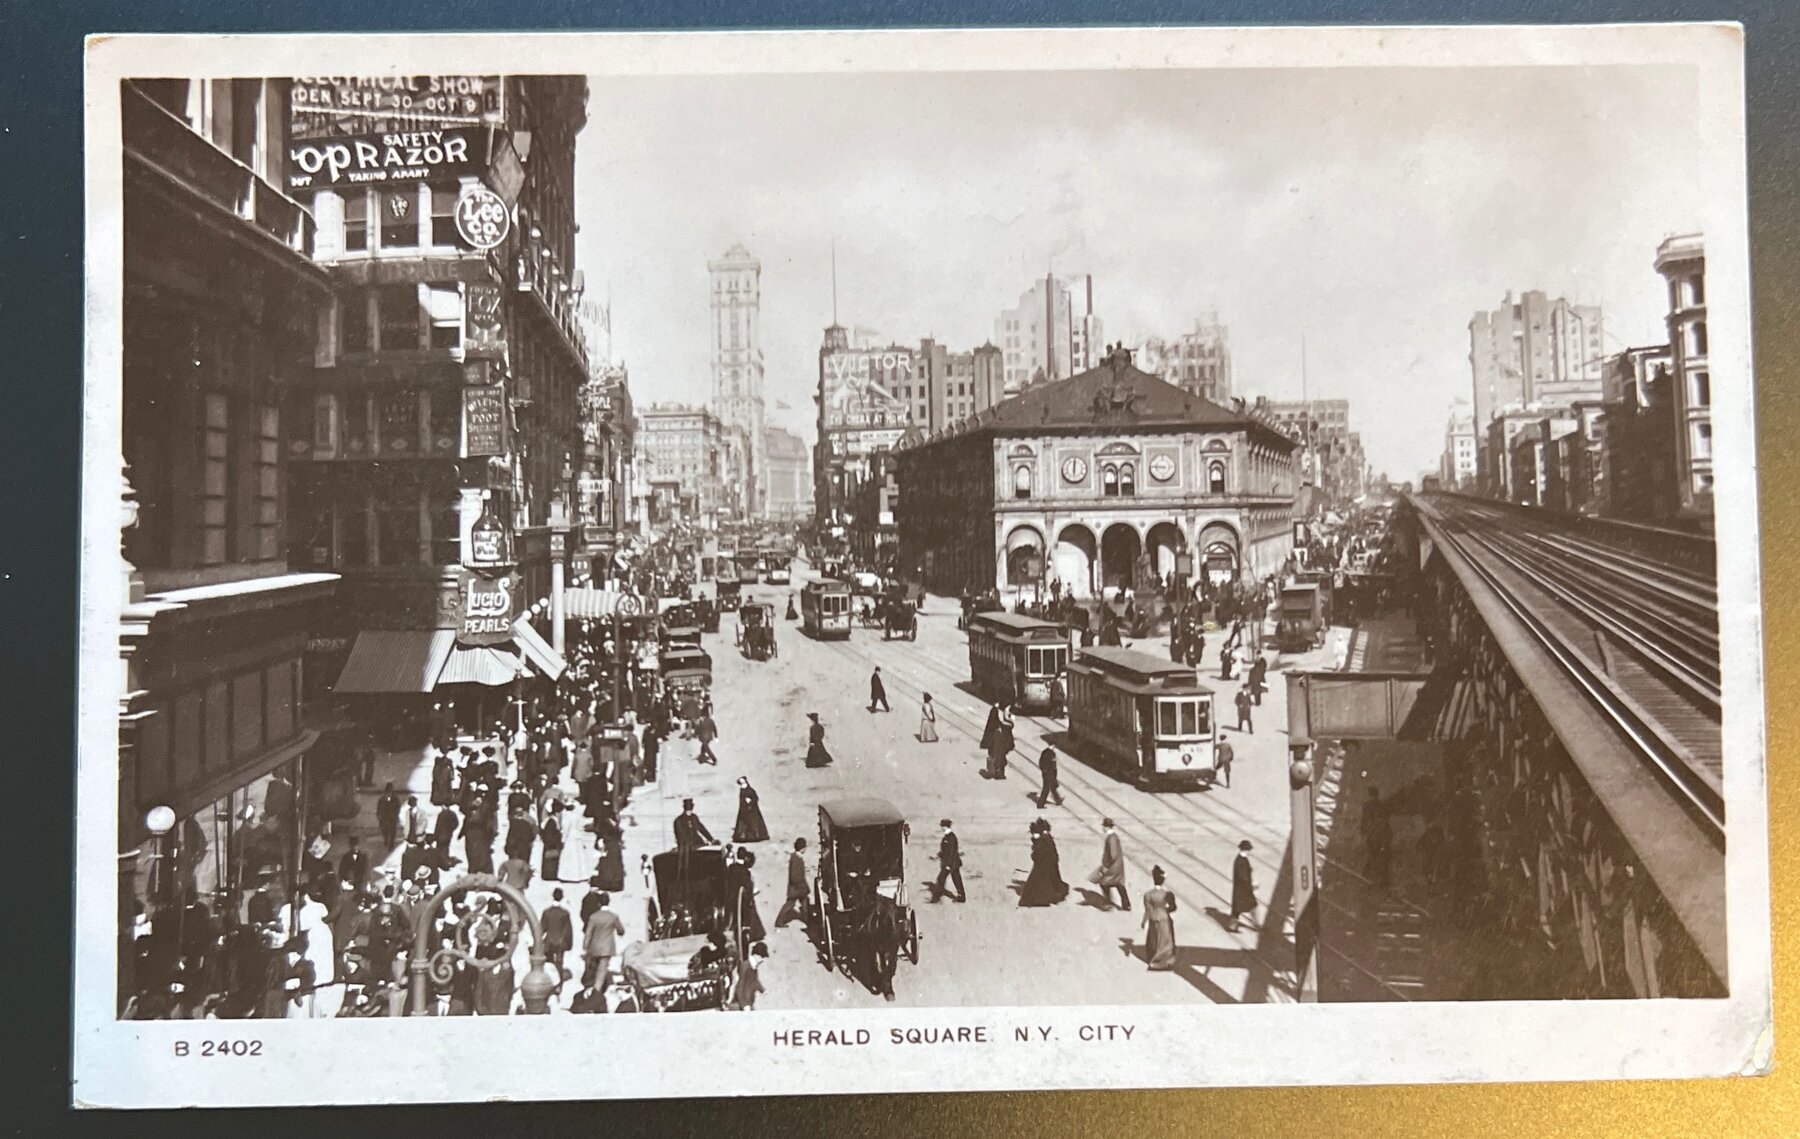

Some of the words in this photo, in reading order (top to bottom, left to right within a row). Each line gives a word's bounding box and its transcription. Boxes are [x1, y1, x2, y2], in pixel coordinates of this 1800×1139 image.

[429, 77, 483, 96] SHOW
[341, 91, 382, 109] SEPT
[392, 95, 413, 110] 30
[426, 97, 456, 112] OCT
[383, 131, 443, 148] SAFETY
[355, 137, 468, 169] RAZOR
[348, 171, 388, 183] TAKING
[391, 168, 430, 181] APART
[831, 354, 912, 381] VICTOR
[464, 618, 510, 635] PEARLS
[773, 1029, 871, 1047] HERALD
[1078, 1024, 1136, 1042] CITY
[174, 1040, 190, 1057] B
[201, 1040, 263, 1057] 2402
